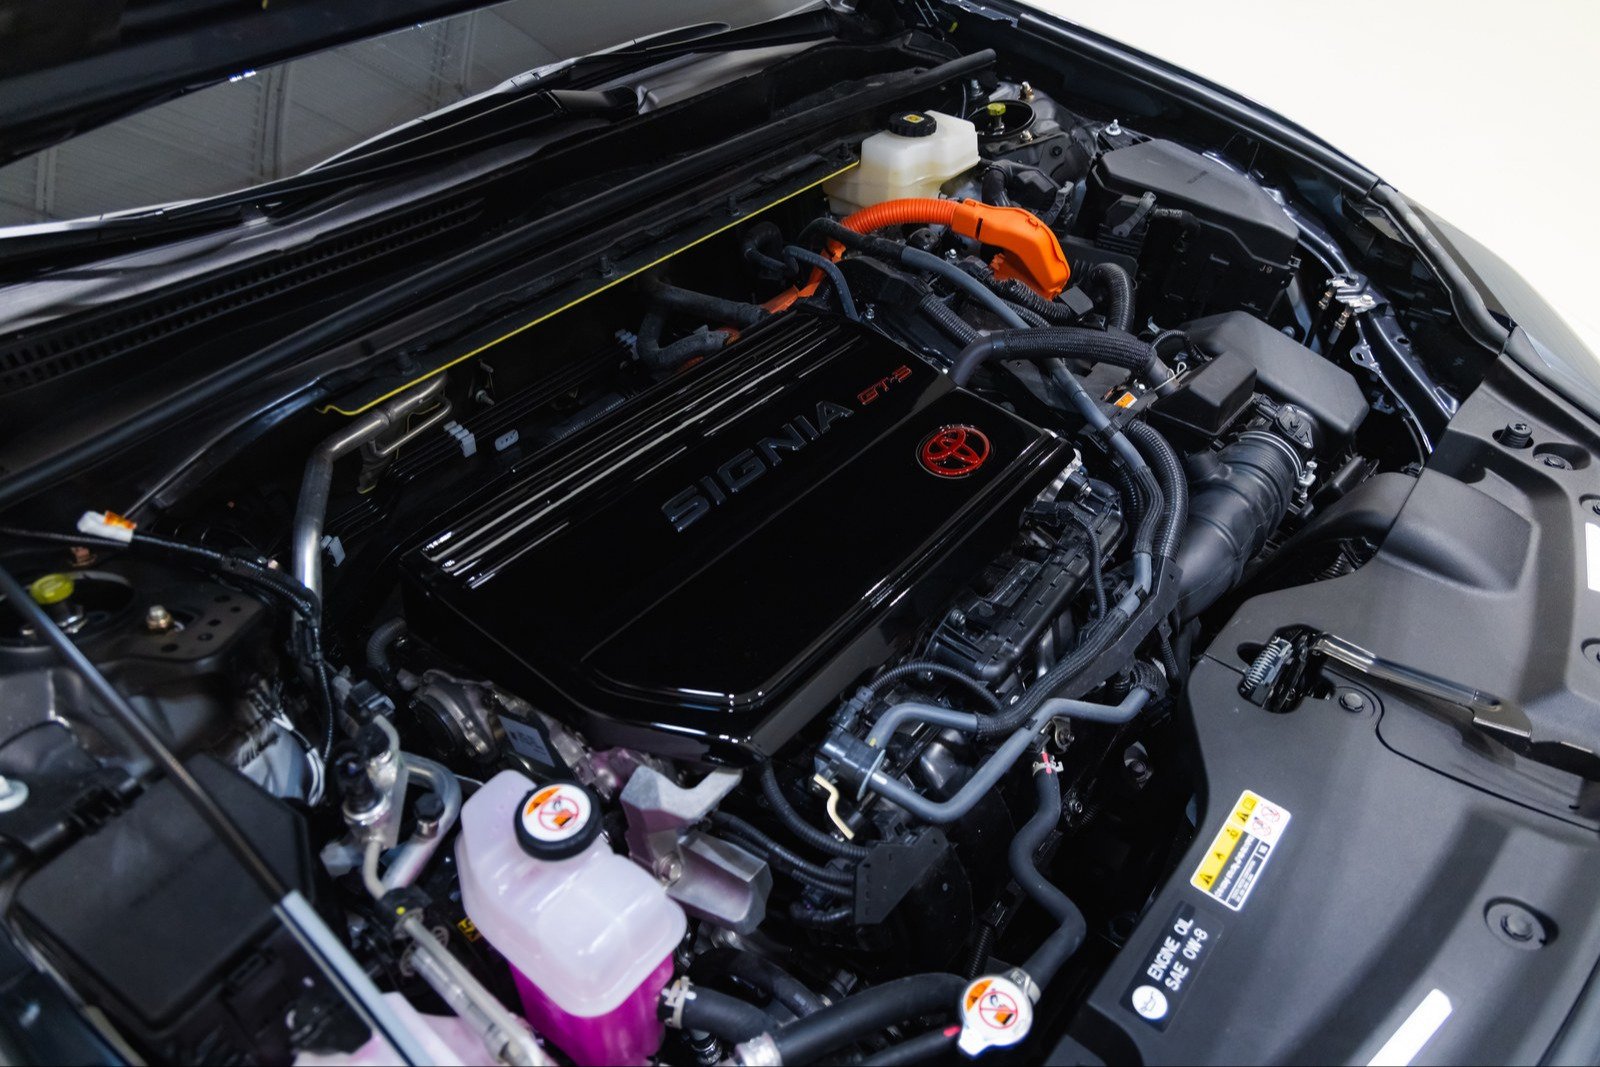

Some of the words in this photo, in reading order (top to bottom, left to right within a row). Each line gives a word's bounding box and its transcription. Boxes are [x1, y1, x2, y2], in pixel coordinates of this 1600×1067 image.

[660, 400, 855, 533] SIGNIA
[857, 364, 913, 406] GT-S
[1146, 936, 1182, 982] ENGINE
[1173, 917, 1194, 936] OIL
[1164, 961, 1190, 992] SAE
[1182, 927, 1209, 960] 0W-8
